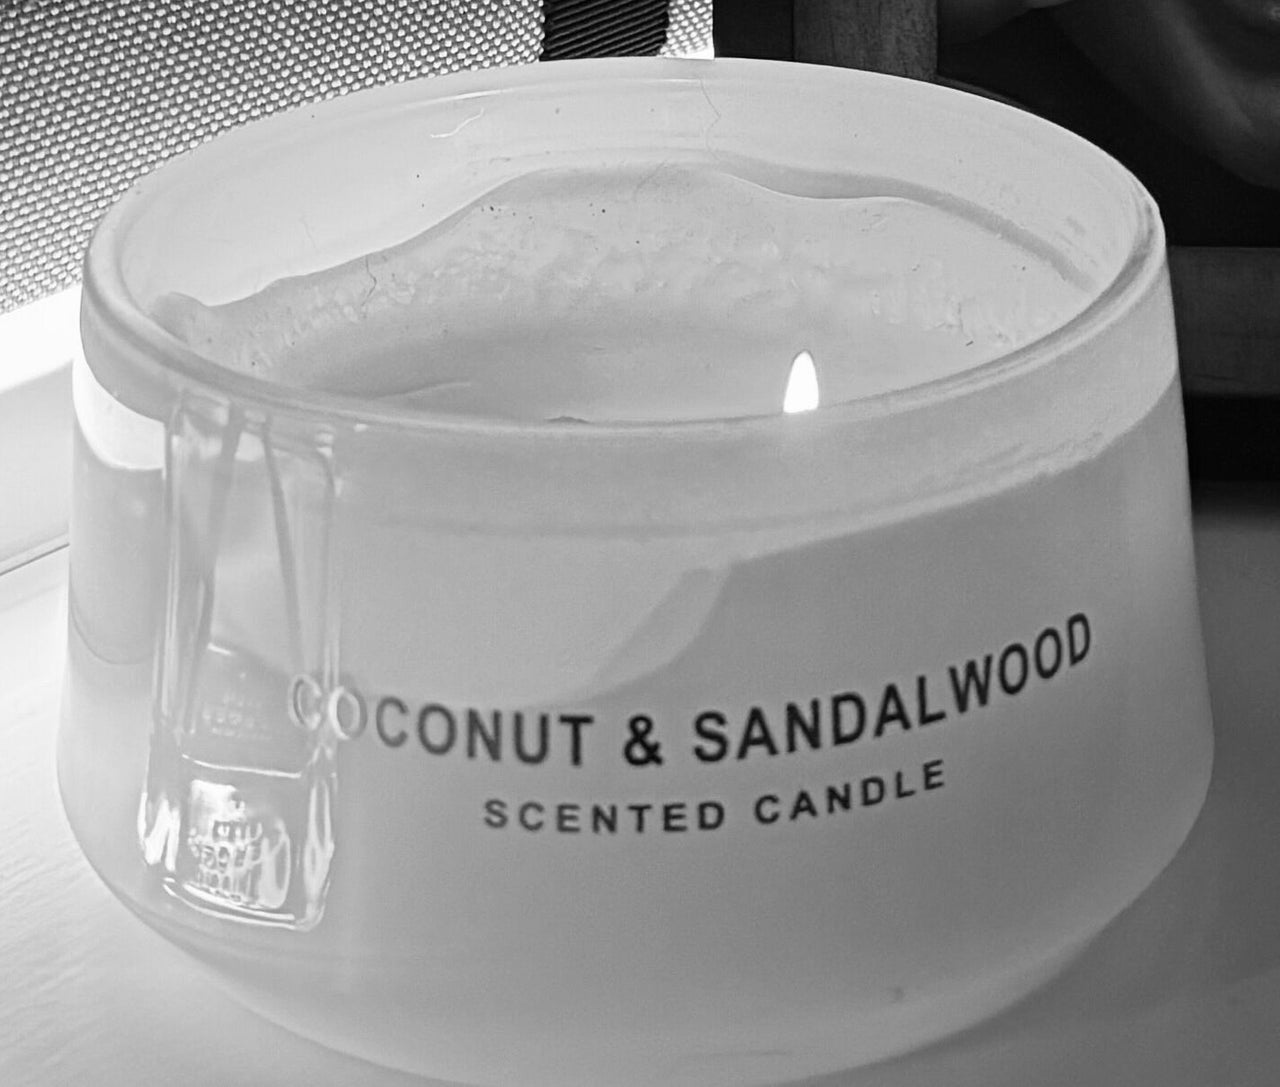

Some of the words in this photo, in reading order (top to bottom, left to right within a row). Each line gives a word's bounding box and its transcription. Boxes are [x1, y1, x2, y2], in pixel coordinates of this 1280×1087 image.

[287, 673, 594, 767] COCONUT
[622, 715, 664, 766] &
[693, 612, 1092, 762] SANDALWOOD
[483, 798, 725, 834] SCENTED
[754, 760, 946, 824] CANDLE
